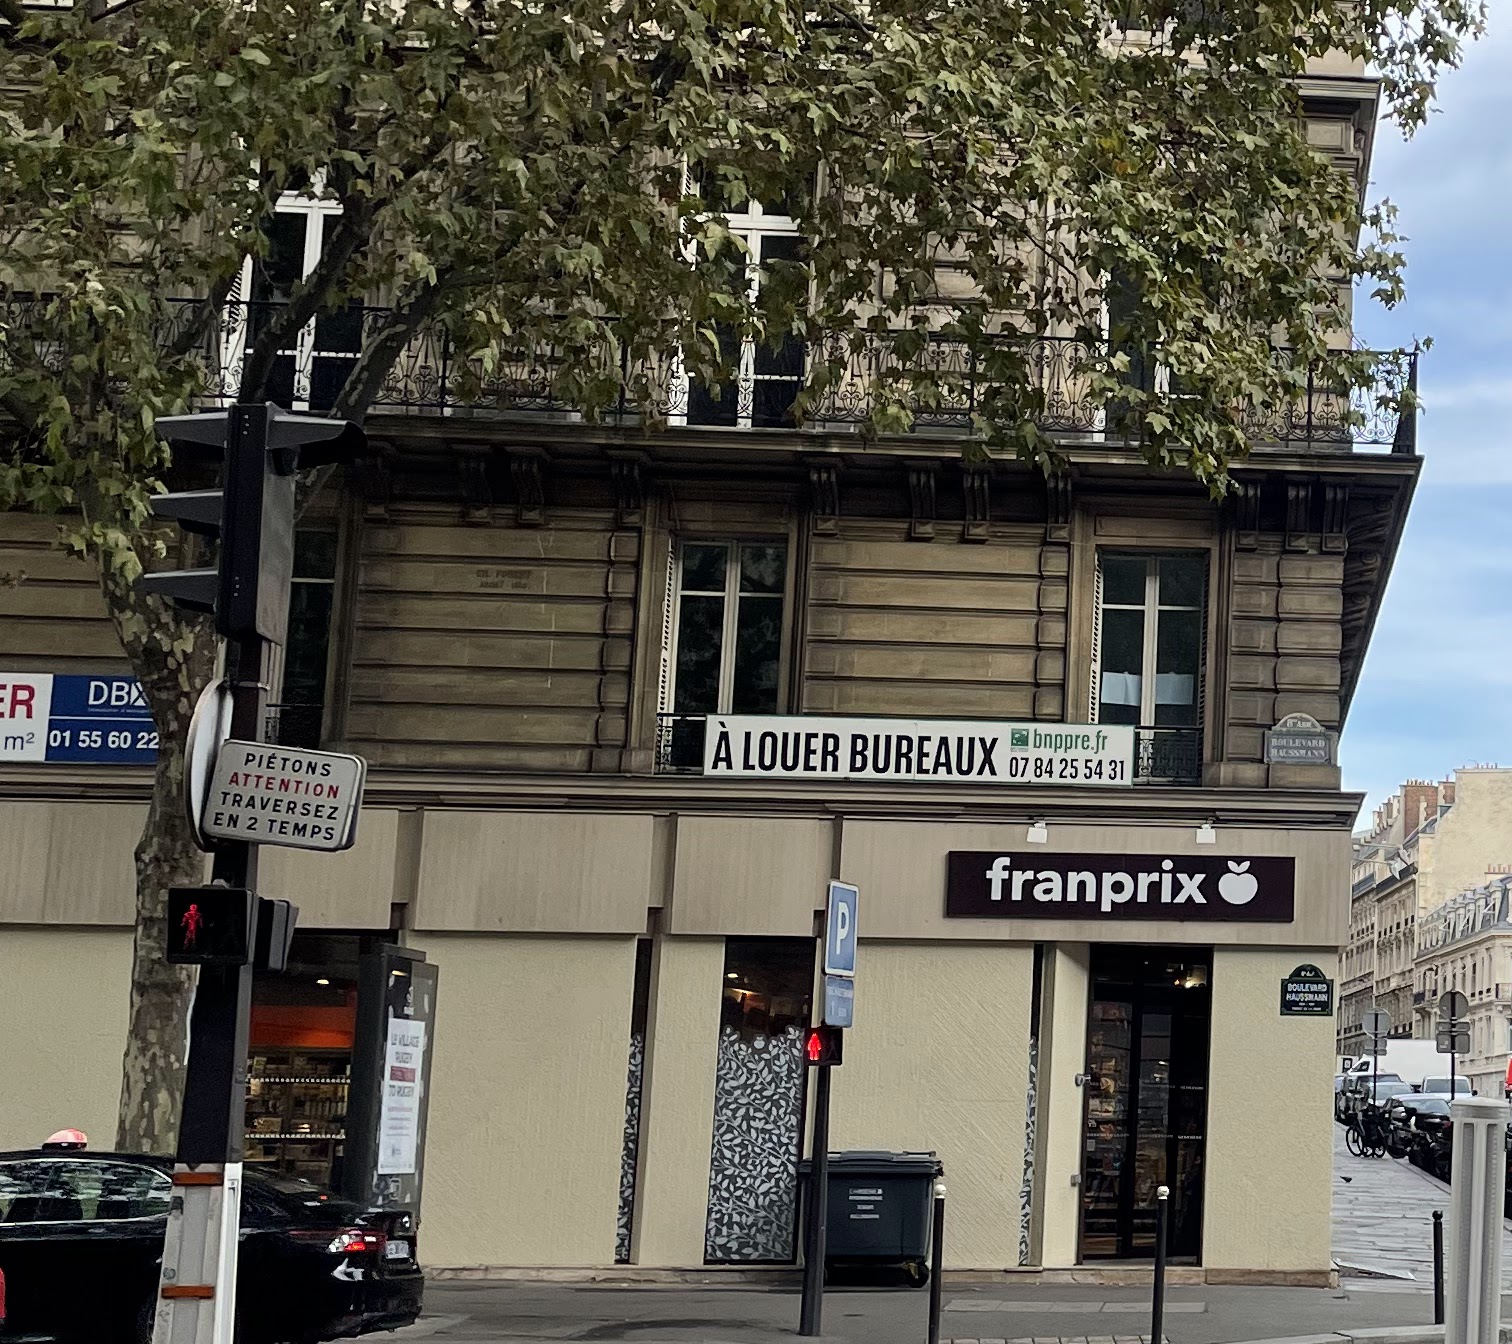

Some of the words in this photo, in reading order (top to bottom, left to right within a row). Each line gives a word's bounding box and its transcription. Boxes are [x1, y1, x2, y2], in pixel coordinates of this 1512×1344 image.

[49, 730, 71, 747] 01
[78, 731, 102, 748] 55
[107, 731, 131, 749] 60
[136, 732, 160, 749] 22
[711, 721, 734, 771] À
[742, 731, 840, 773] LOUER
[849, 733, 999, 777] BUREAUX
[1033, 728, 1108, 754] bnppre.fr
[1271, 738, 1326, 748] BOULEVARD
[243, 752, 332, 777] PIÉTONS
[1271, 748, 1326, 758] HAUSSMANN
[1009, 756, 1030, 778] 07
[1034, 757, 1054, 778] 84
[1059, 757, 1079, 779] 25
[1083, 758, 1103, 780] 54
[1108, 759, 1125, 781] 31
[228, 771, 340, 799] ATTENTION
[220, 791, 340, 821] TRAVERSEZ
[213, 812, 240, 829] EN
[246, 817, 258, 831] 2
[267, 818, 336, 841] TEMPS
[986, 856, 1208, 912] franprix
[835, 901, 850, 955] P
[1286, 993, 1328, 1002] HAUSSMANN
[1287, 983, 1328, 992] BOULEVARD
